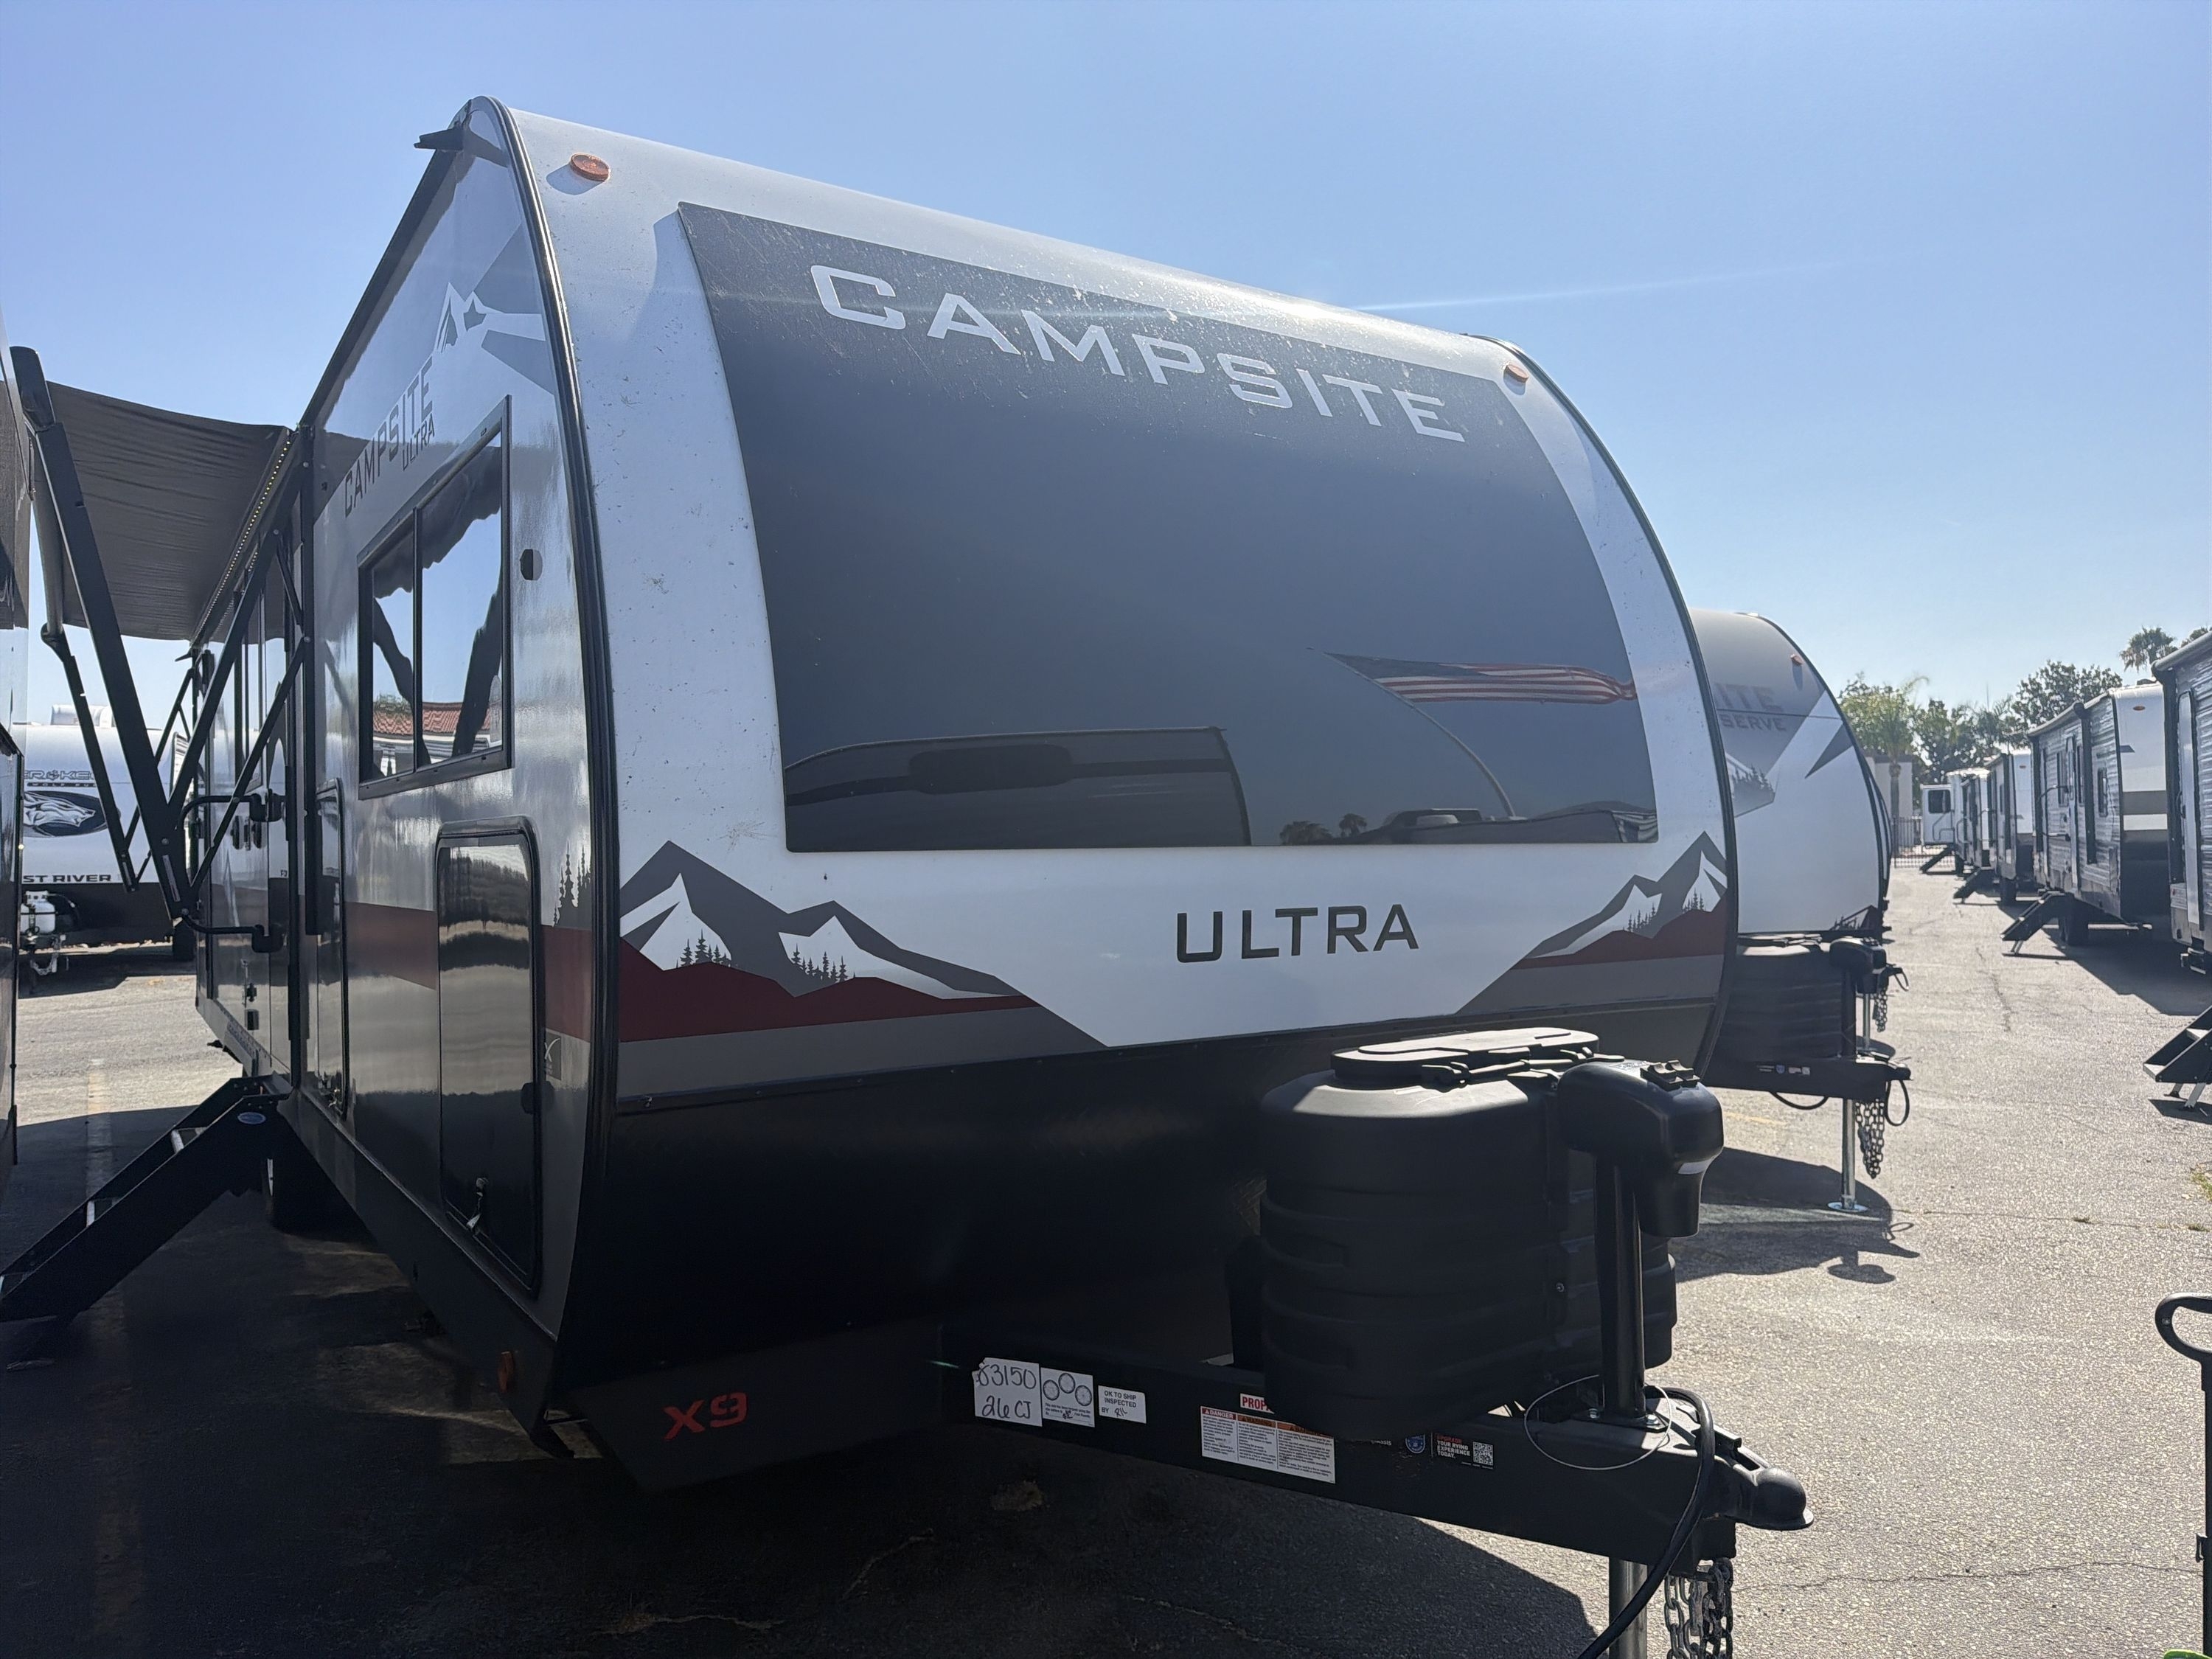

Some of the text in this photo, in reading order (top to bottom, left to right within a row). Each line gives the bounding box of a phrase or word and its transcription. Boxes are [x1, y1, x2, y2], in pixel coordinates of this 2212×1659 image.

[810, 265, 1466, 442] CAMPSITE
[344, 356, 434, 518] CAMPSITE
[403, 413, 435, 471] ULTRA
[52, 874, 111, 883] RIVER
[1177, 903, 1419, 963] ULTRA
[1104, 1397, 1137, 1408] INSPECTED
[1123, 1393, 1137, 1401] SHIP
[1242, 1396, 1270, 1411] PROP
[663, 1392, 748, 1440] X9
[1209, 1411, 1234, 1419] DANGER
[1437, 1445, 1471, 1456] EXPERIENCE
